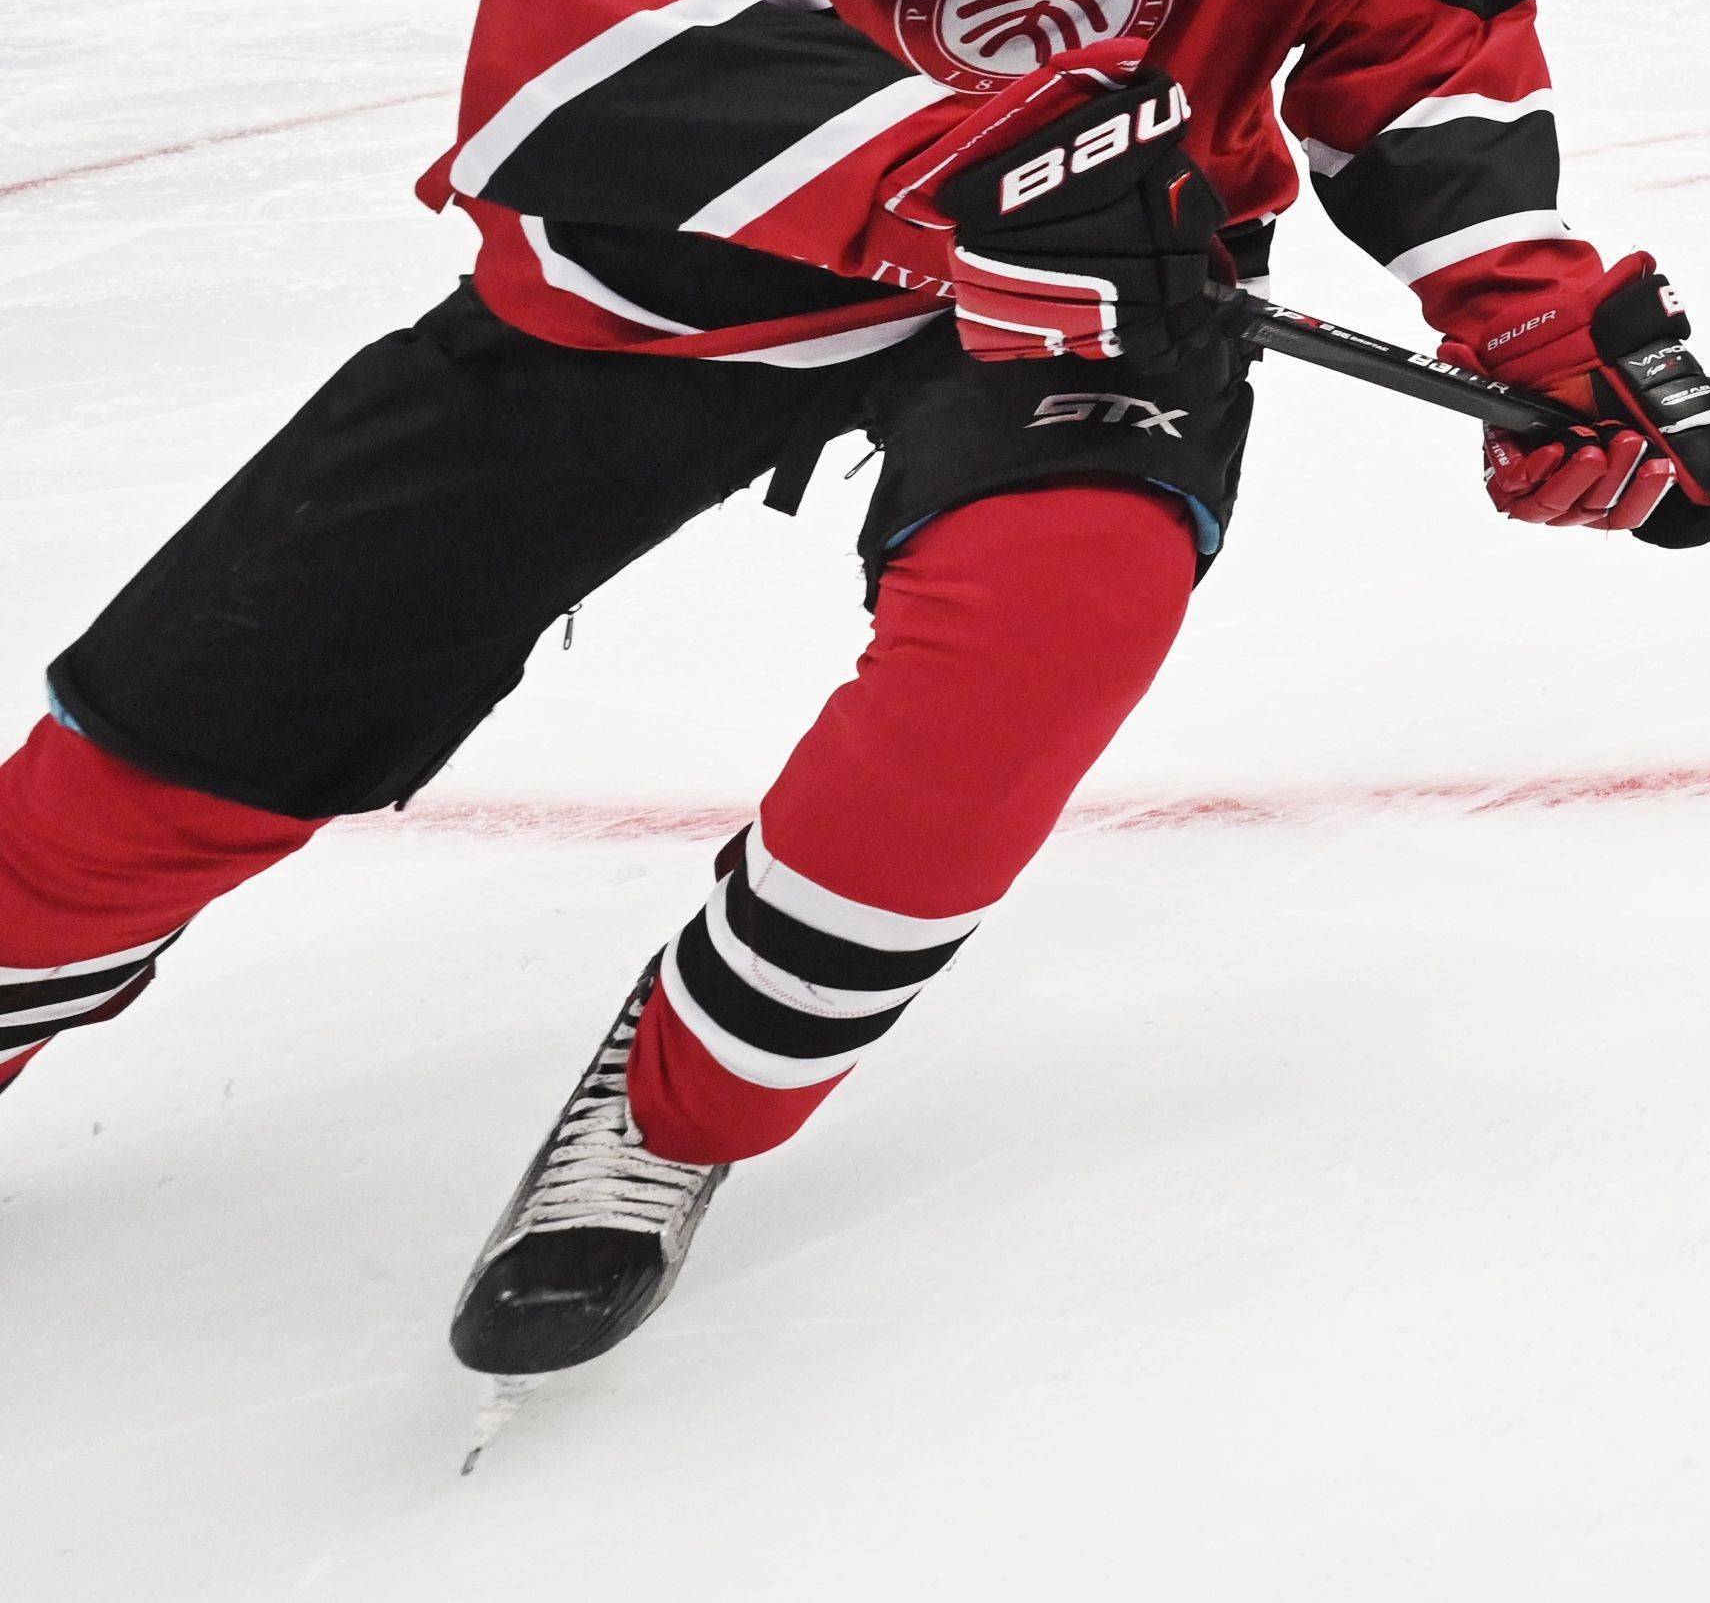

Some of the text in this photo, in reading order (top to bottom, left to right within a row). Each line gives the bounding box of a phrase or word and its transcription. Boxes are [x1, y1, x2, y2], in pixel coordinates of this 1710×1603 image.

[1000, 82, 1192, 215] BAU
[1486, 309, 1558, 351] BAUER
[1023, 392, 1190, 439] STX
